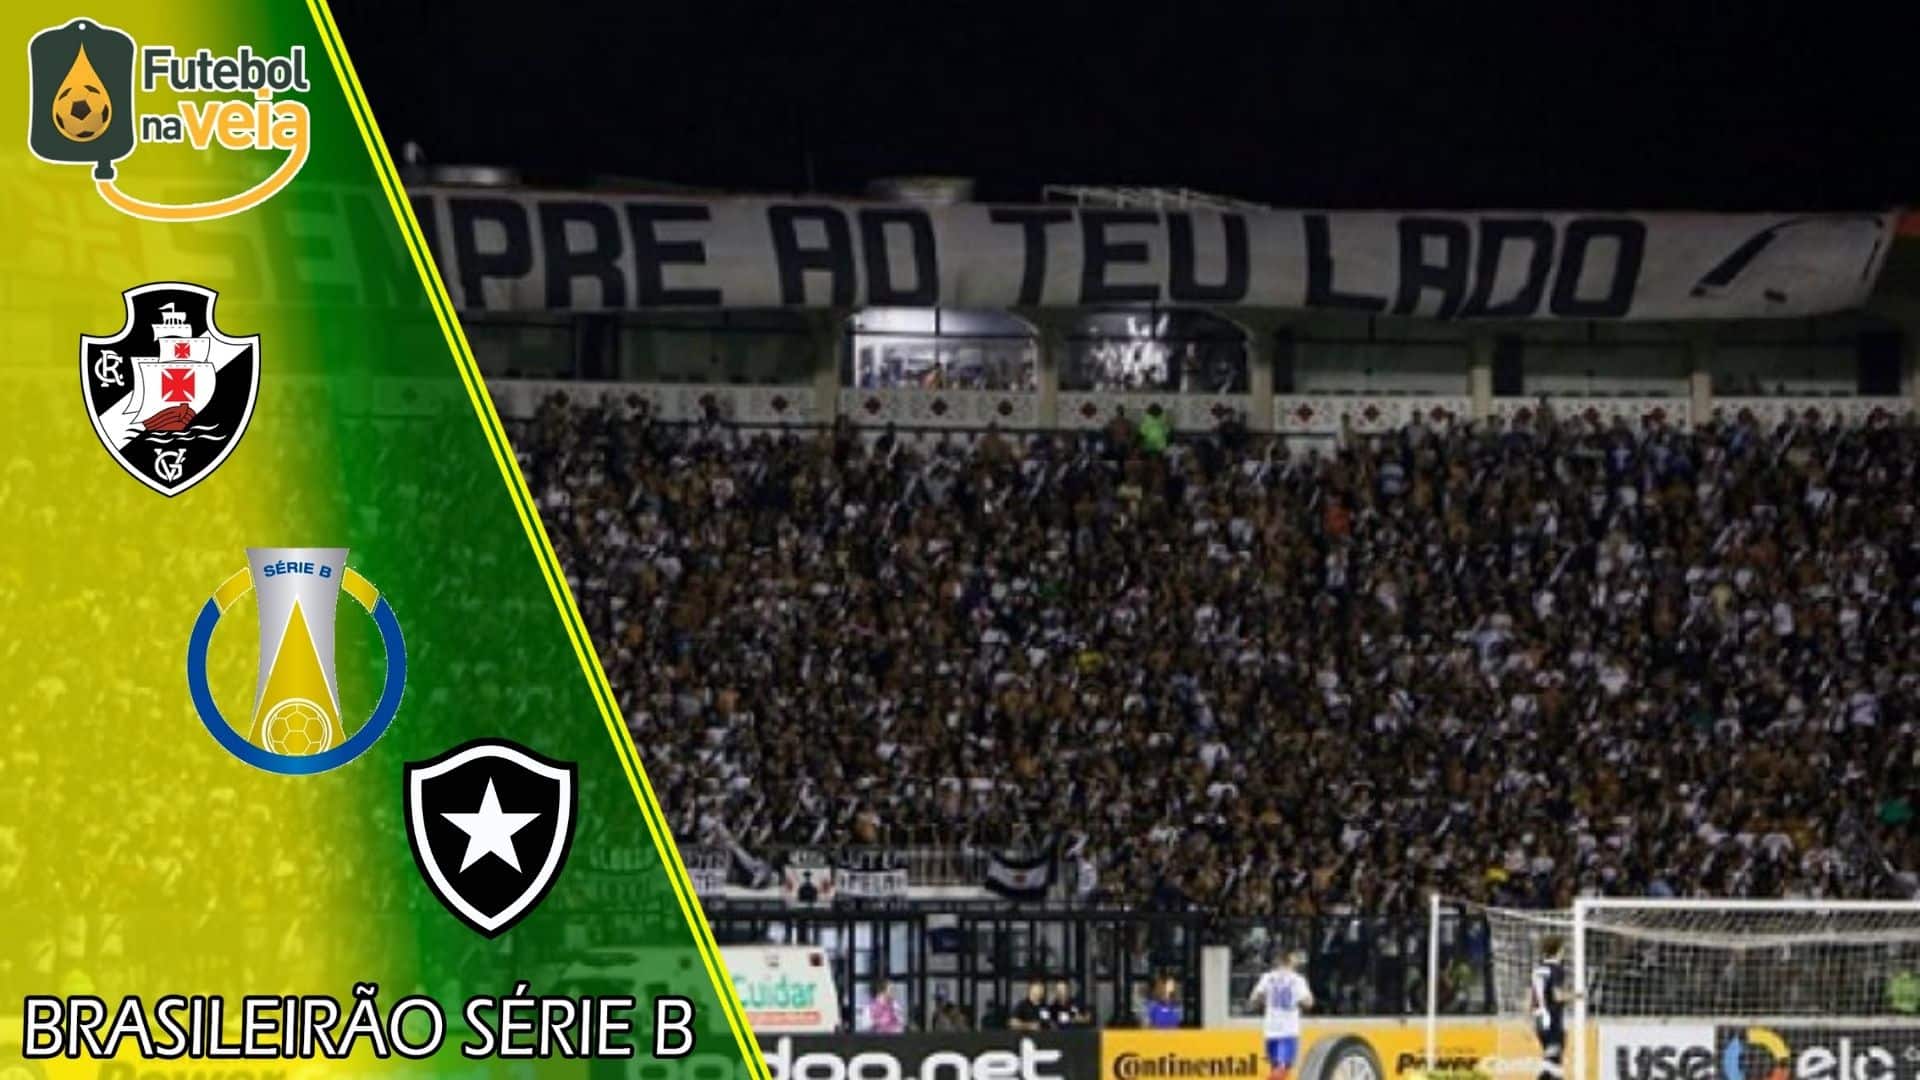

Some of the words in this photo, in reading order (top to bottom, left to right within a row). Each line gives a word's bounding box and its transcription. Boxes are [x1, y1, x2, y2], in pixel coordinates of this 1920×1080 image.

[988, 208, 1250, 306] TEU
[1304, 214, 1647, 320] LADO
[1113, 1052, 1258, 1080] Continental
[1615, 1045, 1714, 1080] use
